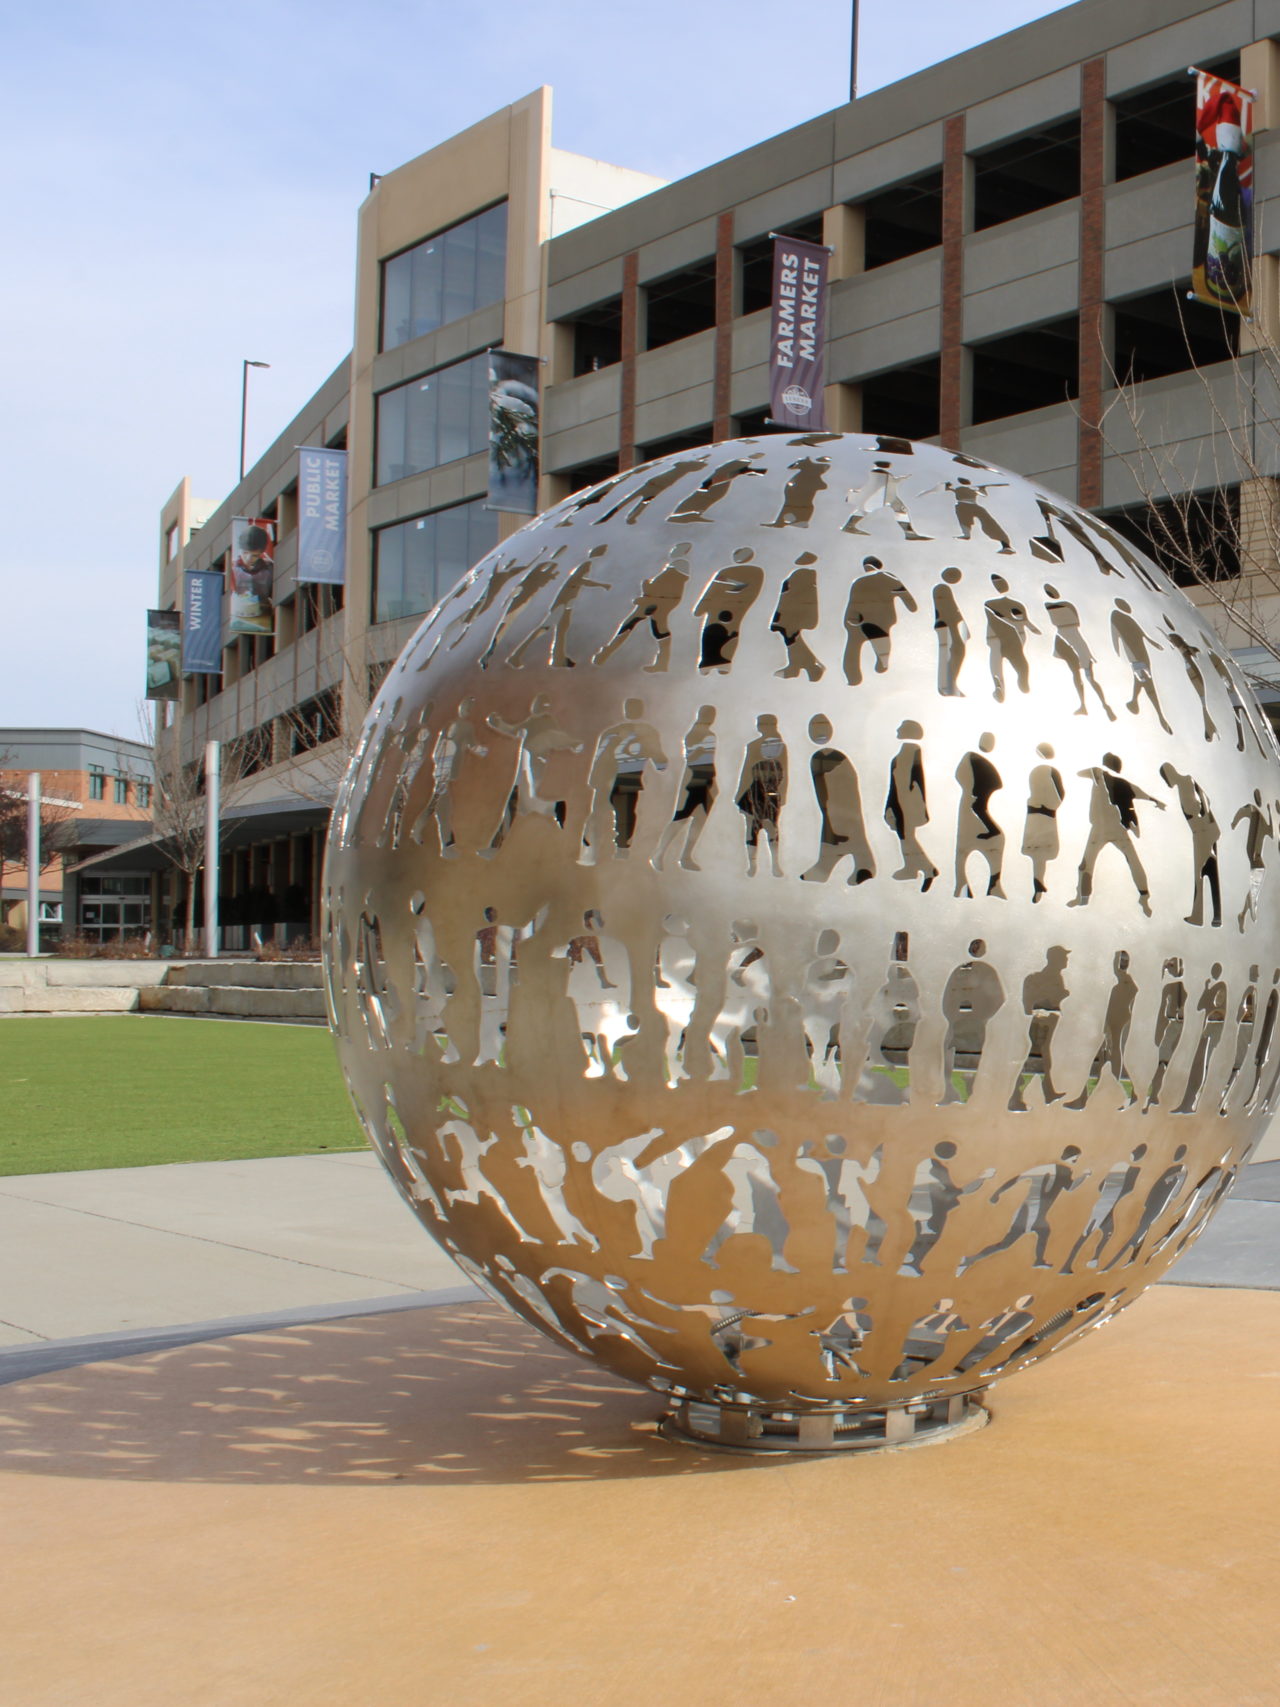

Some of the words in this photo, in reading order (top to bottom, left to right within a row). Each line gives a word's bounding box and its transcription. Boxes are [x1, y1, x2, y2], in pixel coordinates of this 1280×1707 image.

[777, 253, 799, 368] FARMERS
[799, 257, 820, 362] MARKET
[306, 457, 321, 519] PUBLIC
[324, 459, 340, 532] MARKET
[189, 578, 203, 631] WINTER
